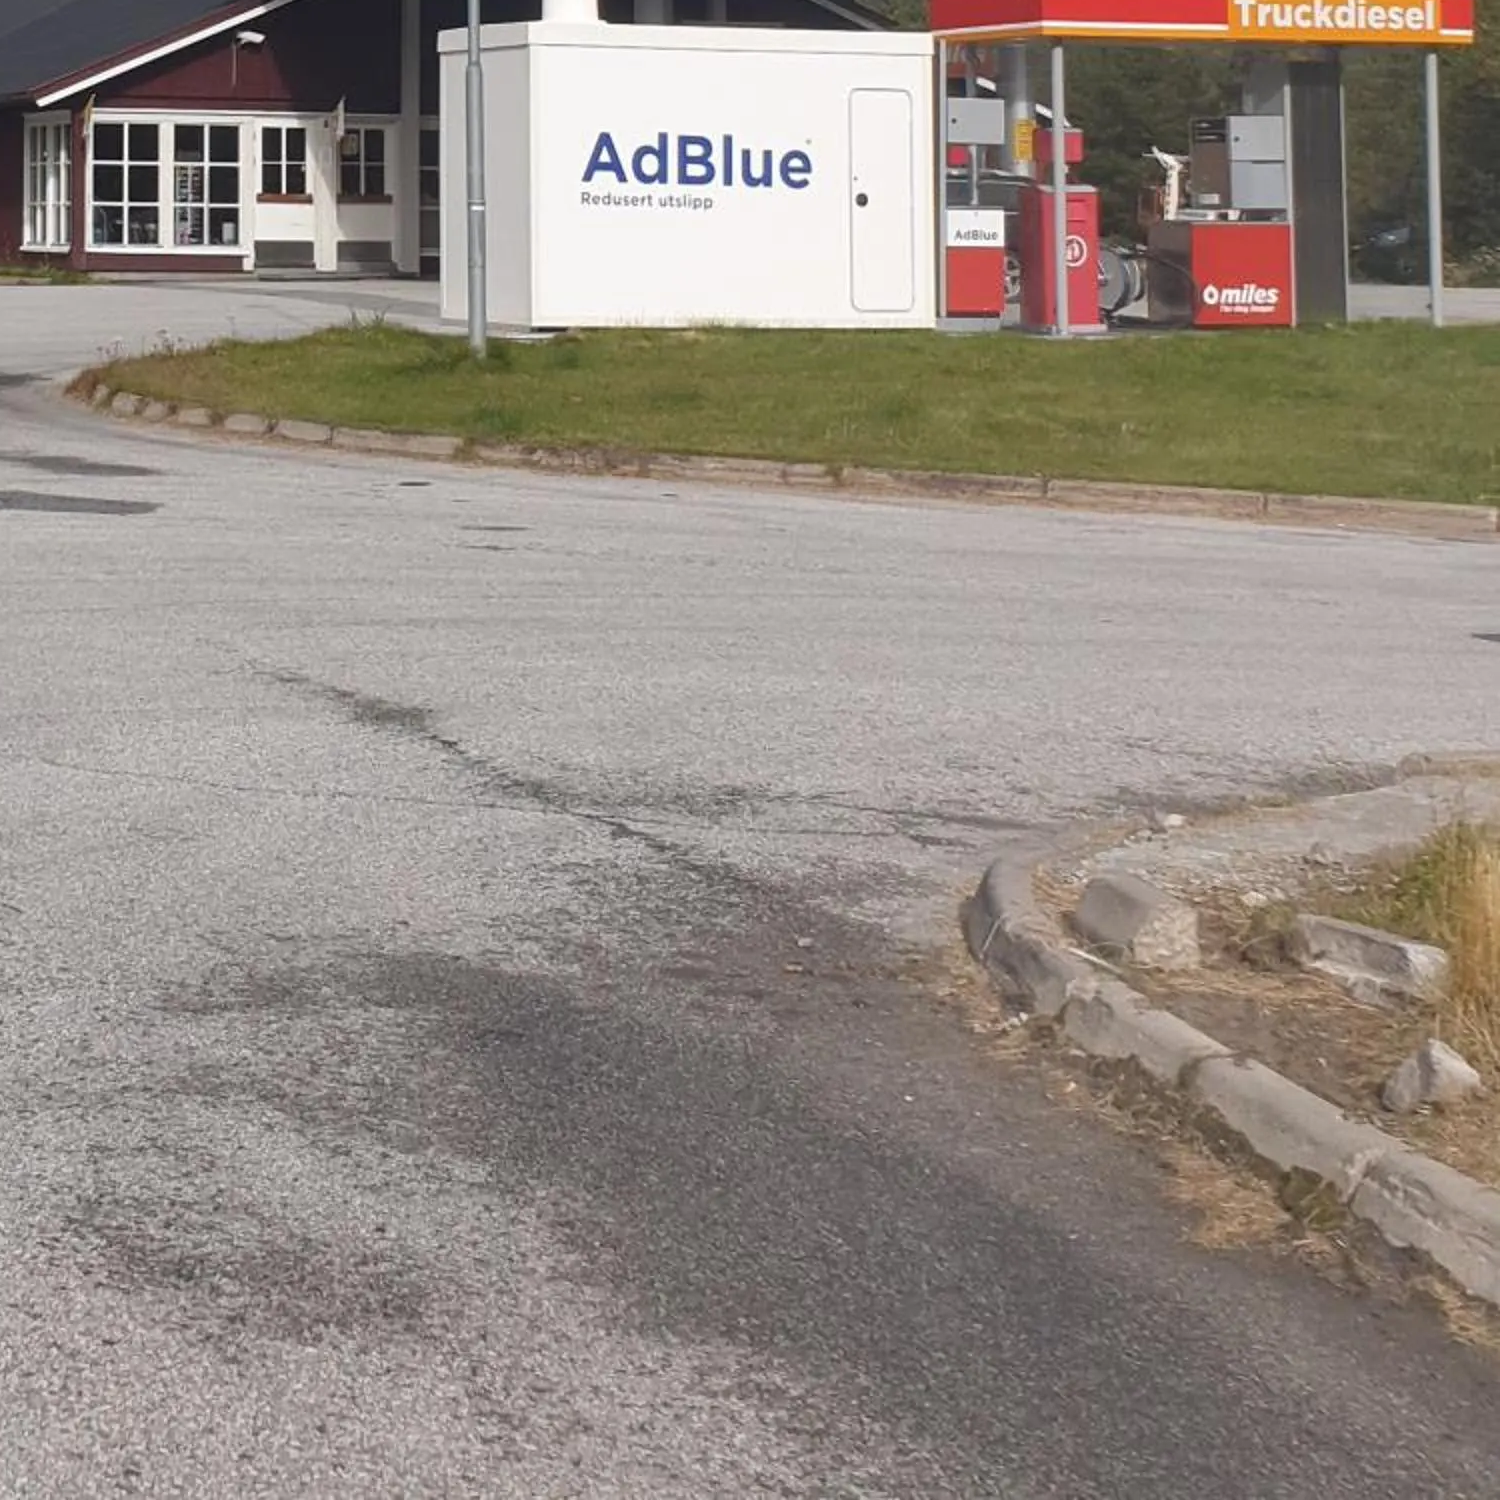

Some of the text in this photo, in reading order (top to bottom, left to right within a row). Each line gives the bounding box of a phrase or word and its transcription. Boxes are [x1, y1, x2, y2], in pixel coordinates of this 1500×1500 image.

[581, 131, 813, 189] AdBlue
[580, 191, 714, 210] Redusert utslipp
[954, 229, 999, 242] AdBlue
[1220, 283, 1280, 305] miles
